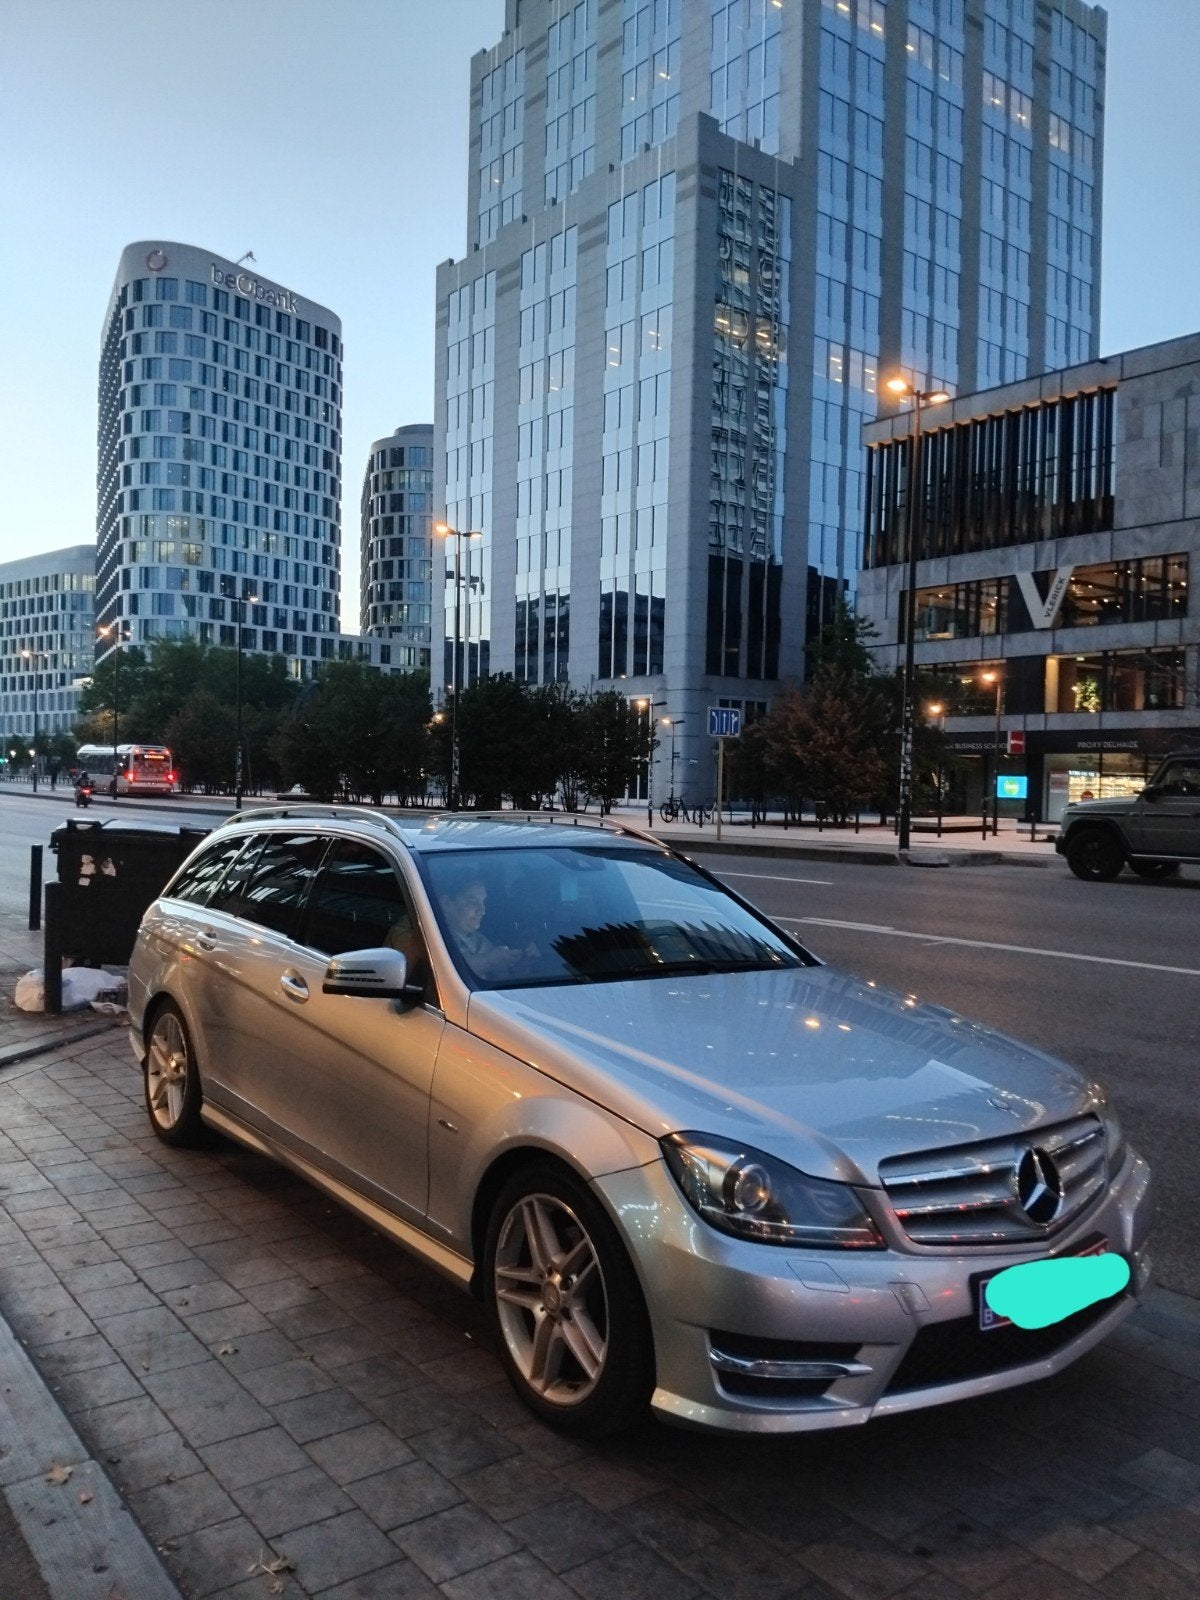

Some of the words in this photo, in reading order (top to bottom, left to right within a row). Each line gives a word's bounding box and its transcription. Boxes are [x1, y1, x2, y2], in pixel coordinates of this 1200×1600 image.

[1015, 565, 1075, 630] V
[1044, 577, 1065, 617] VLERICK
[1077, 741, 1101, 749] PROXY
[984, 1308, 994, 1325] B
